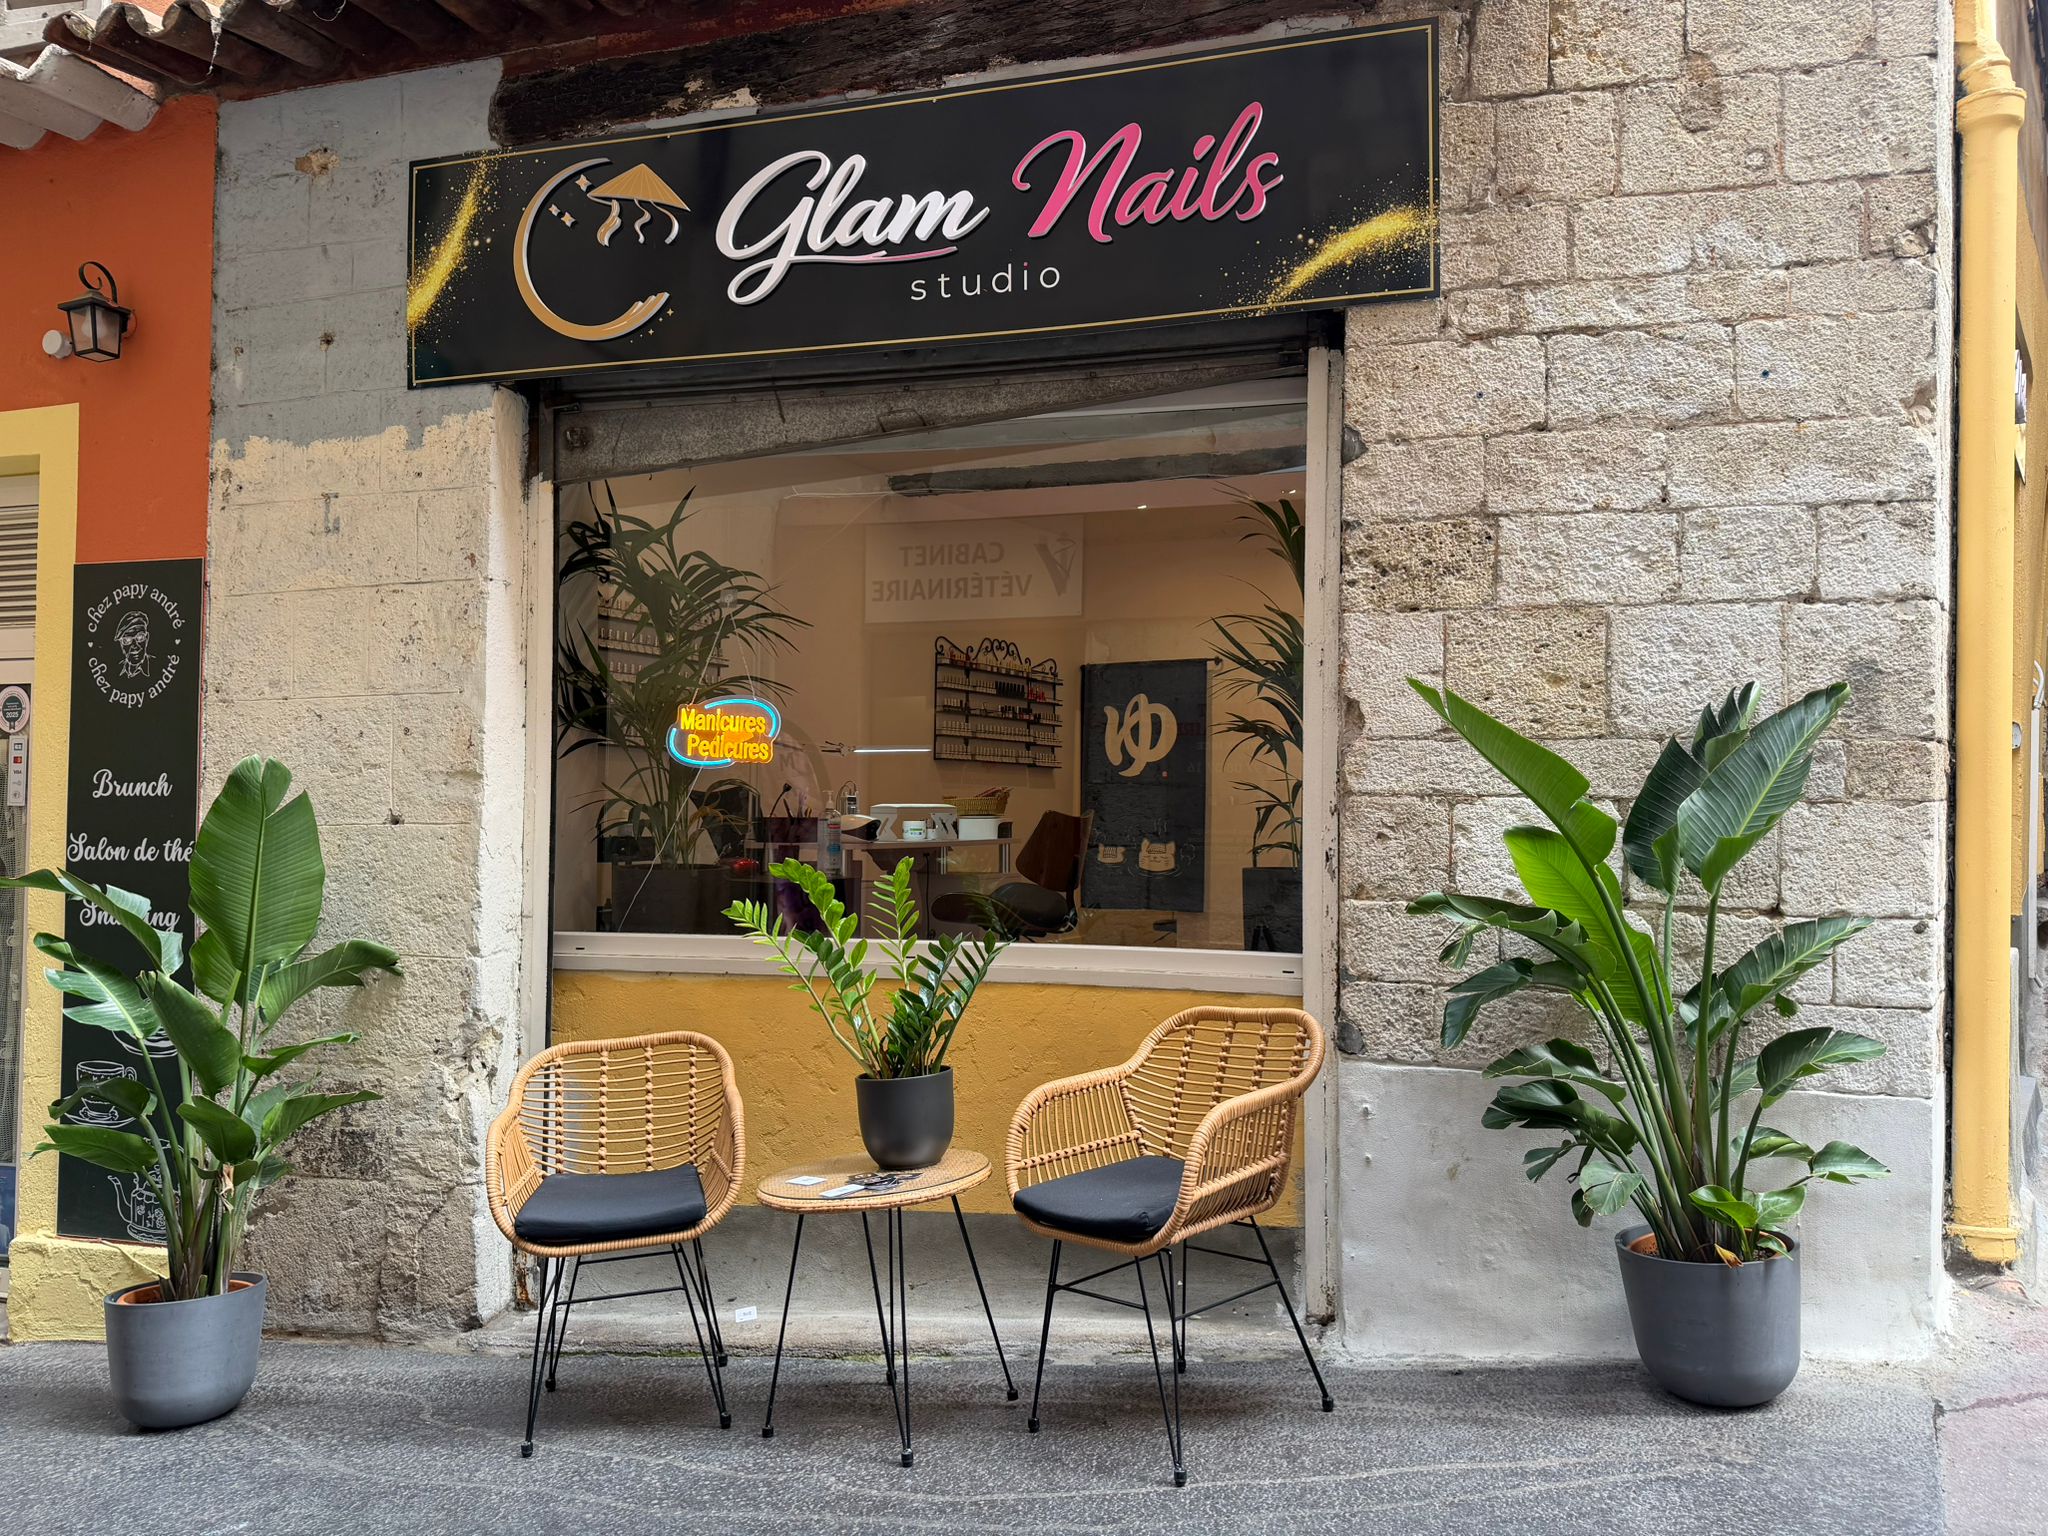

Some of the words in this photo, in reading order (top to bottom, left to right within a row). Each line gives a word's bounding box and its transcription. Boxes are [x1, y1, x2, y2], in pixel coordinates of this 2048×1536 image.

[715, 150, 990, 305] Glam
[1012, 101, 1284, 243] Nails
[910, 261, 1061, 301] studio
[87, 596, 112, 633] chez
[112, 583, 148, 605] papy
[150, 588, 186, 630] andré
[88, 657, 111, 694] chez
[109, 688, 145, 709] papy
[148, 654, 180, 699] andré
[680, 708, 766, 734] Manicures
[1104, 693, 1178, 777] ゆ
[687, 733, 769, 760] Pedicures
[92, 769, 173, 798] Brunch
[67, 832, 130, 862] Salon
[133, 838, 160, 861] de
[162, 838, 196, 862] thé
